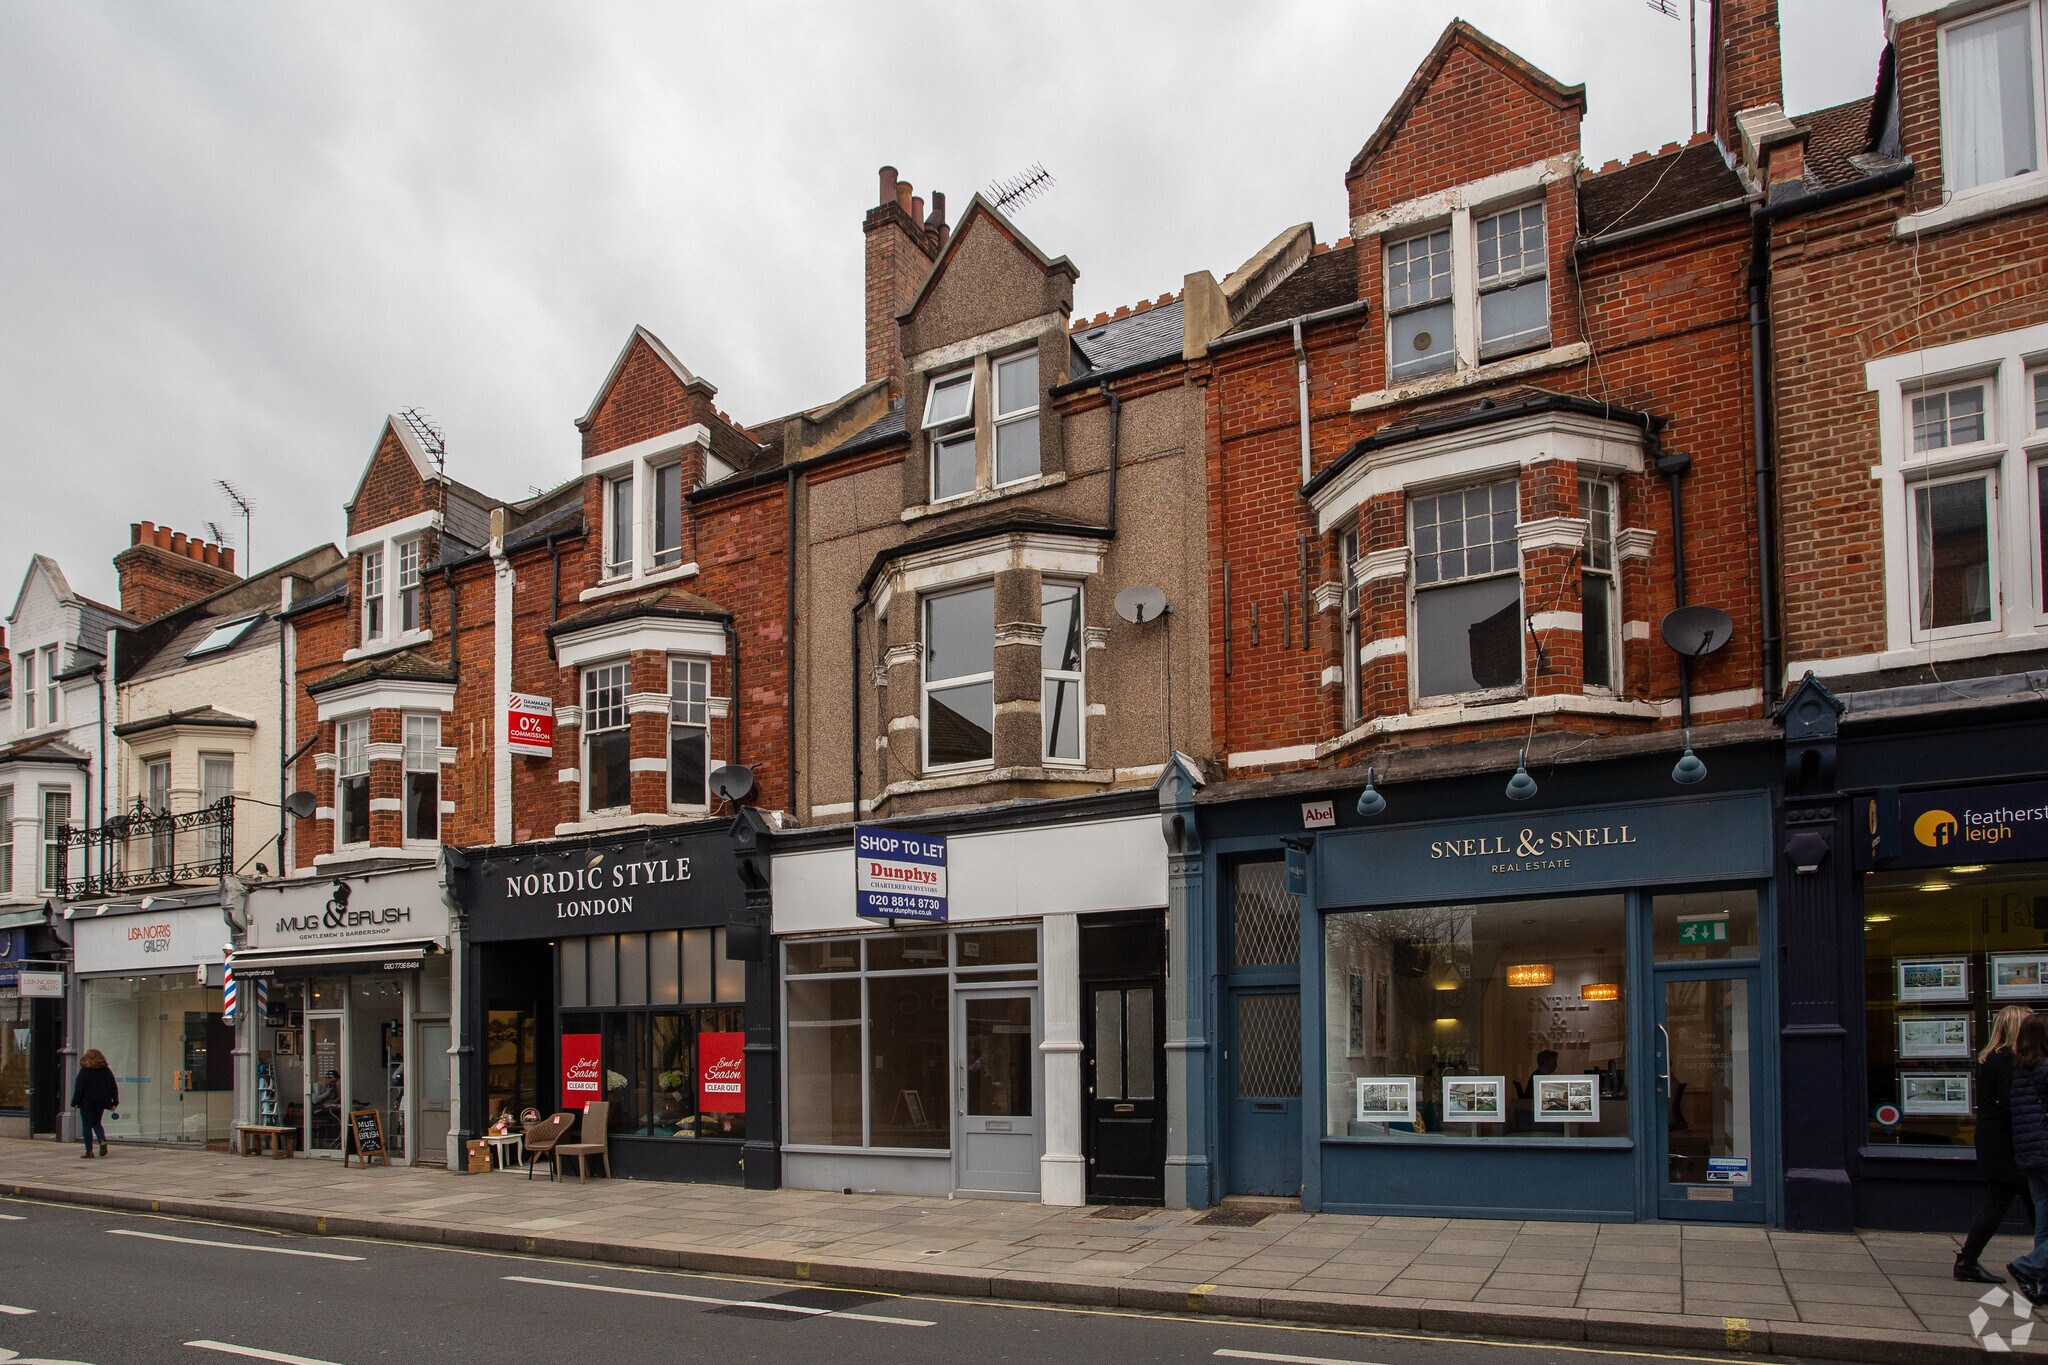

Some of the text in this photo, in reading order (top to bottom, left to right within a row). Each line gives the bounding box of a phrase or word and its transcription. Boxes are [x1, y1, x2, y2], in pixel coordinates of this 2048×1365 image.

[520, 717, 542, 732] 0%
[510, 730, 550, 740] COMMISSION
[1305, 807, 1333, 822] Abel
[1966, 824, 2012, 844] leigh
[860, 836, 944, 858] SHOP TO LET
[1431, 826, 1636, 859] SNELL & SNELL
[870, 862, 937, 884] Dunphys
[1491, 859, 1570, 873] REAL ESTATE
[506, 857, 692, 898] NORDIC STYLE
[870, 882, 938, 893] CHARTERED SURVEYORS
[557, 896, 633, 918] LONDON
[869, 894, 940, 910] 020 8814 8730
[280, 915, 318, 932] MUG
[323, 900, 347, 928] &
[348, 906, 411, 926] BRUSH
[879, 906, 932, 916] www.dunphys.co.uk
[128, 924, 170, 940] LISA NORRIS
[300, 928, 390, 940] GENTLEMEN'S BARBERSHOP
[144, 938, 170, 952] GALLERY
[1527, 1030, 1590, 1050] SNELL
[578, 1058, 598, 1069] End of
[717, 1056, 742, 1070] End of
[566, 1066, 598, 1079] Season
[704, 1066, 742, 1080] Season
[358, 1131, 379, 1140] BRUSH
